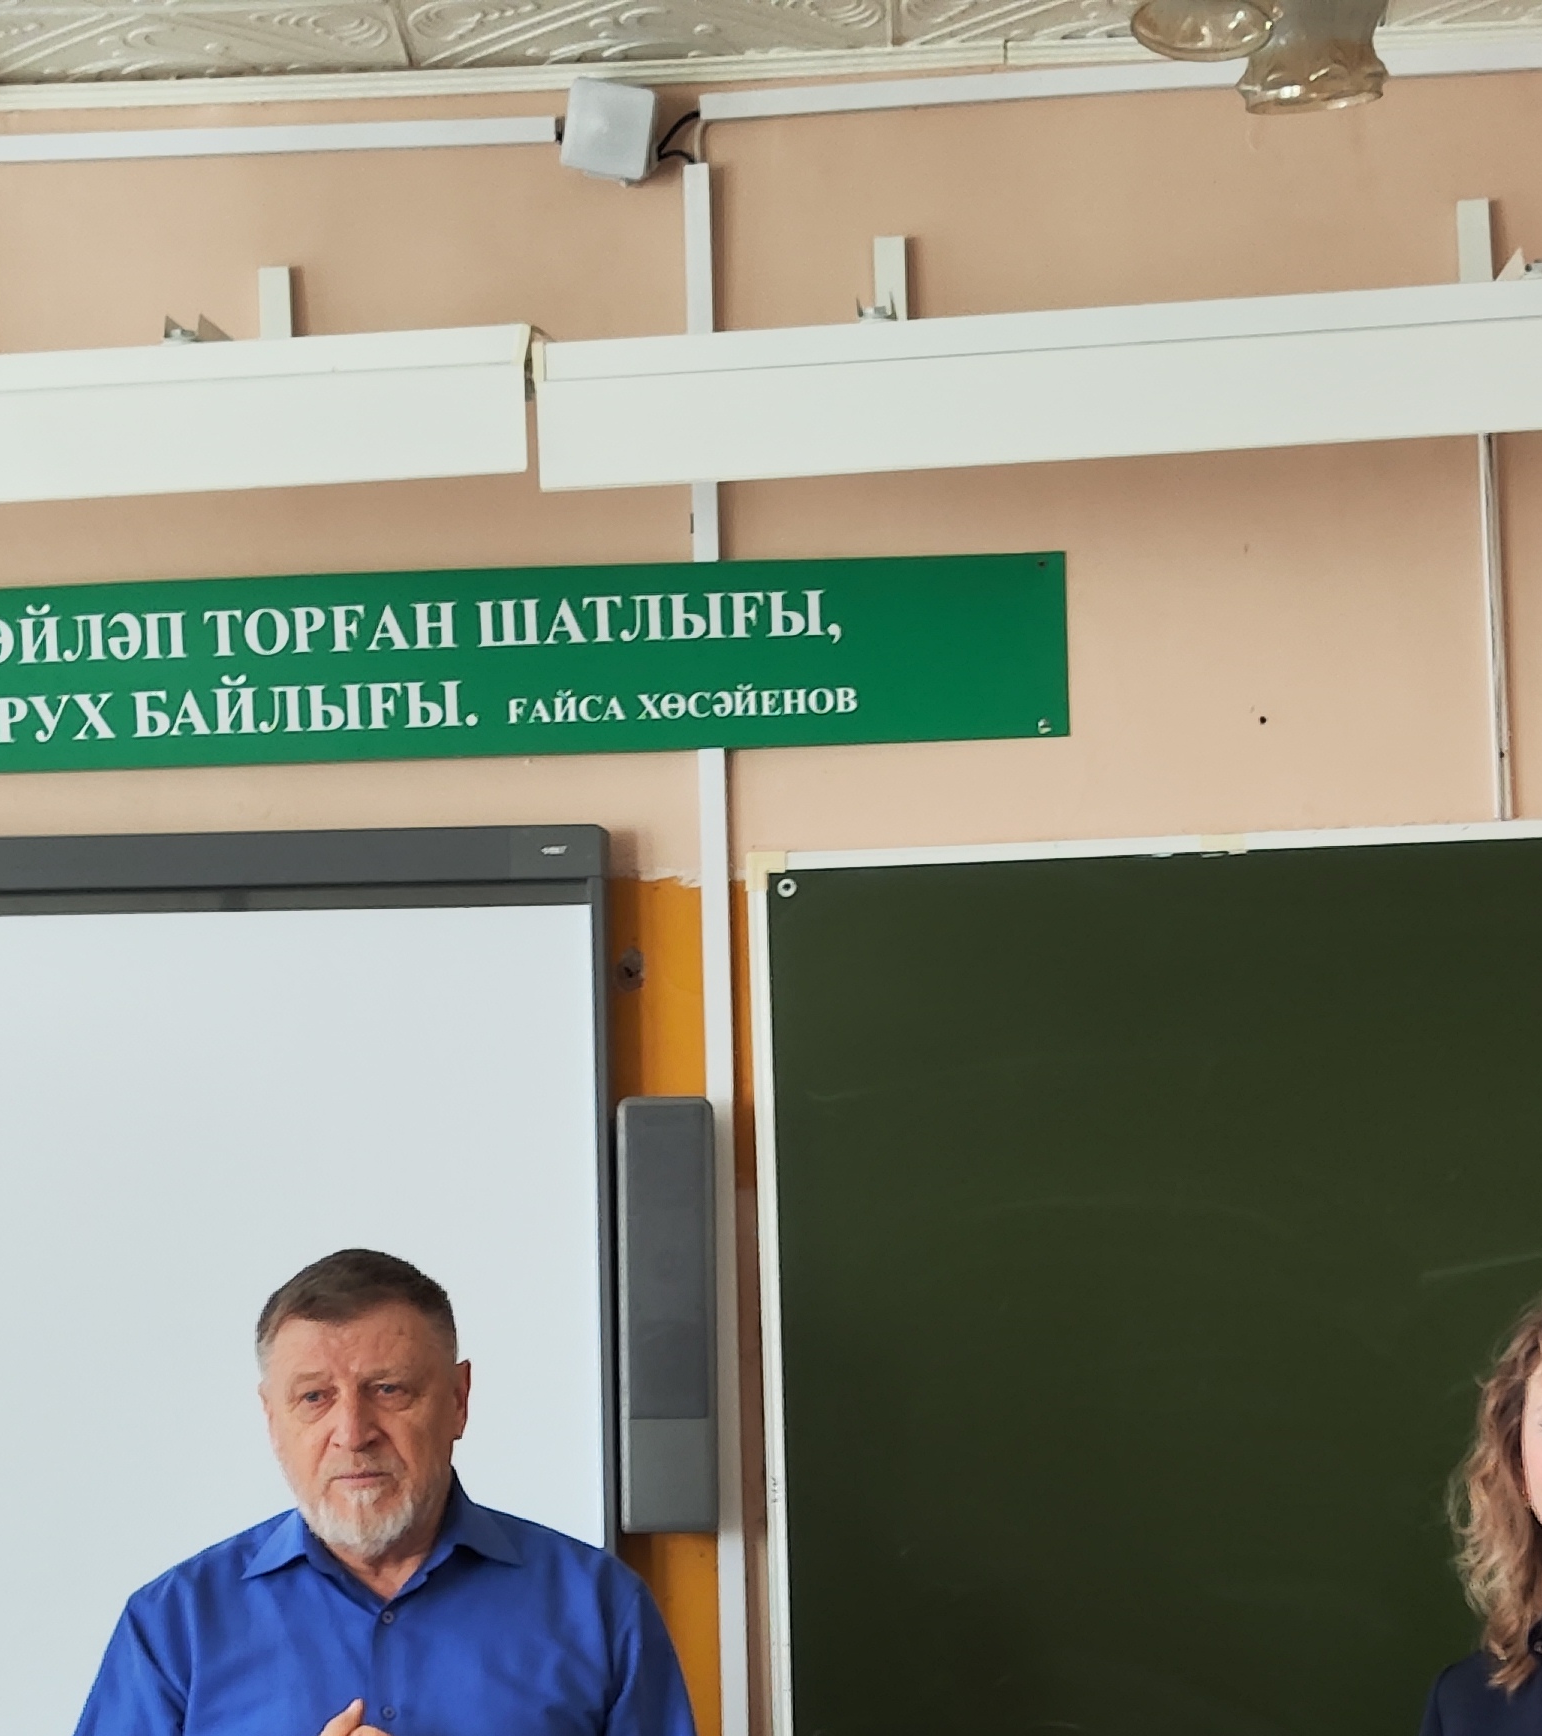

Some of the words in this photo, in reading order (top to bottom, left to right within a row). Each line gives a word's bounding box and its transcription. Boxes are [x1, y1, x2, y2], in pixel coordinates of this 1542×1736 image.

[203, 601, 459, 659] ТОРҒАН
[476, 589, 844, 648] ШАТЛЫҒЫ,
[130, 674, 479, 739] БАЙЛЫҒЫ.
[637, 683, 858, 720] ХӨСӘЙЕНОВ
